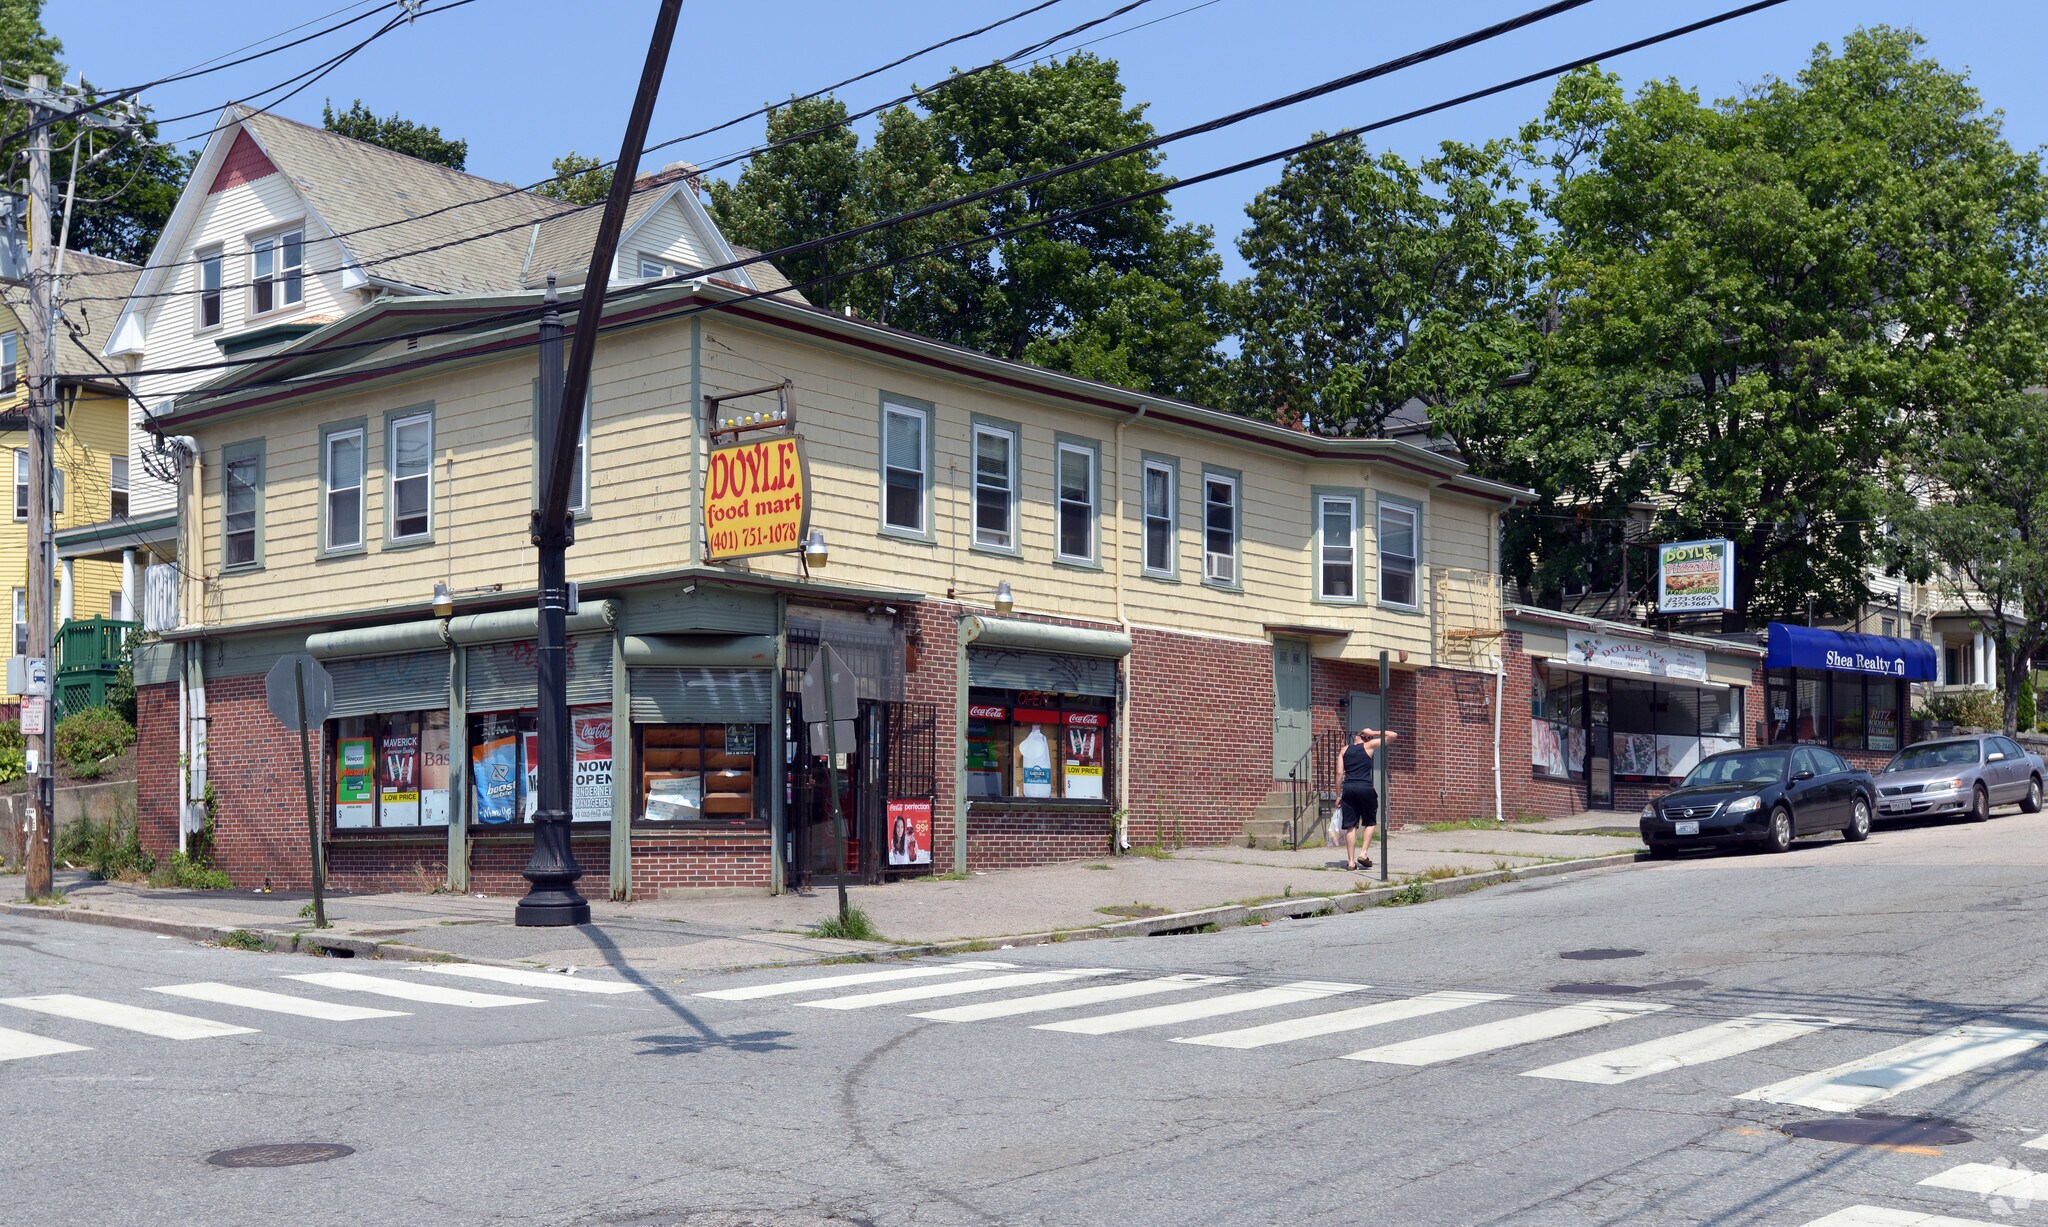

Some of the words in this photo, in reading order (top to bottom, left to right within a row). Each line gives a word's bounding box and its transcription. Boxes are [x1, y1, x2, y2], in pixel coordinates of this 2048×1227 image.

[711, 442, 795, 501] DOYLE
[707, 499, 749, 529] food
[755, 492, 802, 517] mart
[710, 530, 738, 555] (401)
[742, 522, 797, 547] 751-1078
[1666, 545, 1711, 562] DOYLE
[1672, 595, 1712, 603] 273-5660
[1672, 600, 1711, 608] 273-5661
[1602, 644, 1642, 657] DOYLE
[1645, 649, 1667, 664] AVE
[1826, 651, 1853, 667] Shea
[1856, 653, 1891, 675] Realty
[1017, 692, 1049, 706] OPEN
[1871, 710, 1891, 720] RITZ
[383, 737, 418, 747] MAVERICK
[346, 755, 363, 763] Newport
[424, 752, 450, 767] Bas
[578, 761, 612, 772] NOW
[576, 774, 612, 785] OPEN
[487, 781, 516, 796] boost
[576, 786, 599, 797] UNDER
[575, 797, 612, 809] MANAGEMEN
[904, 803, 929, 811] perfection
[338, 810, 342, 819] $
[383, 808, 387, 817] $
[916, 823, 929, 833] 99¢
